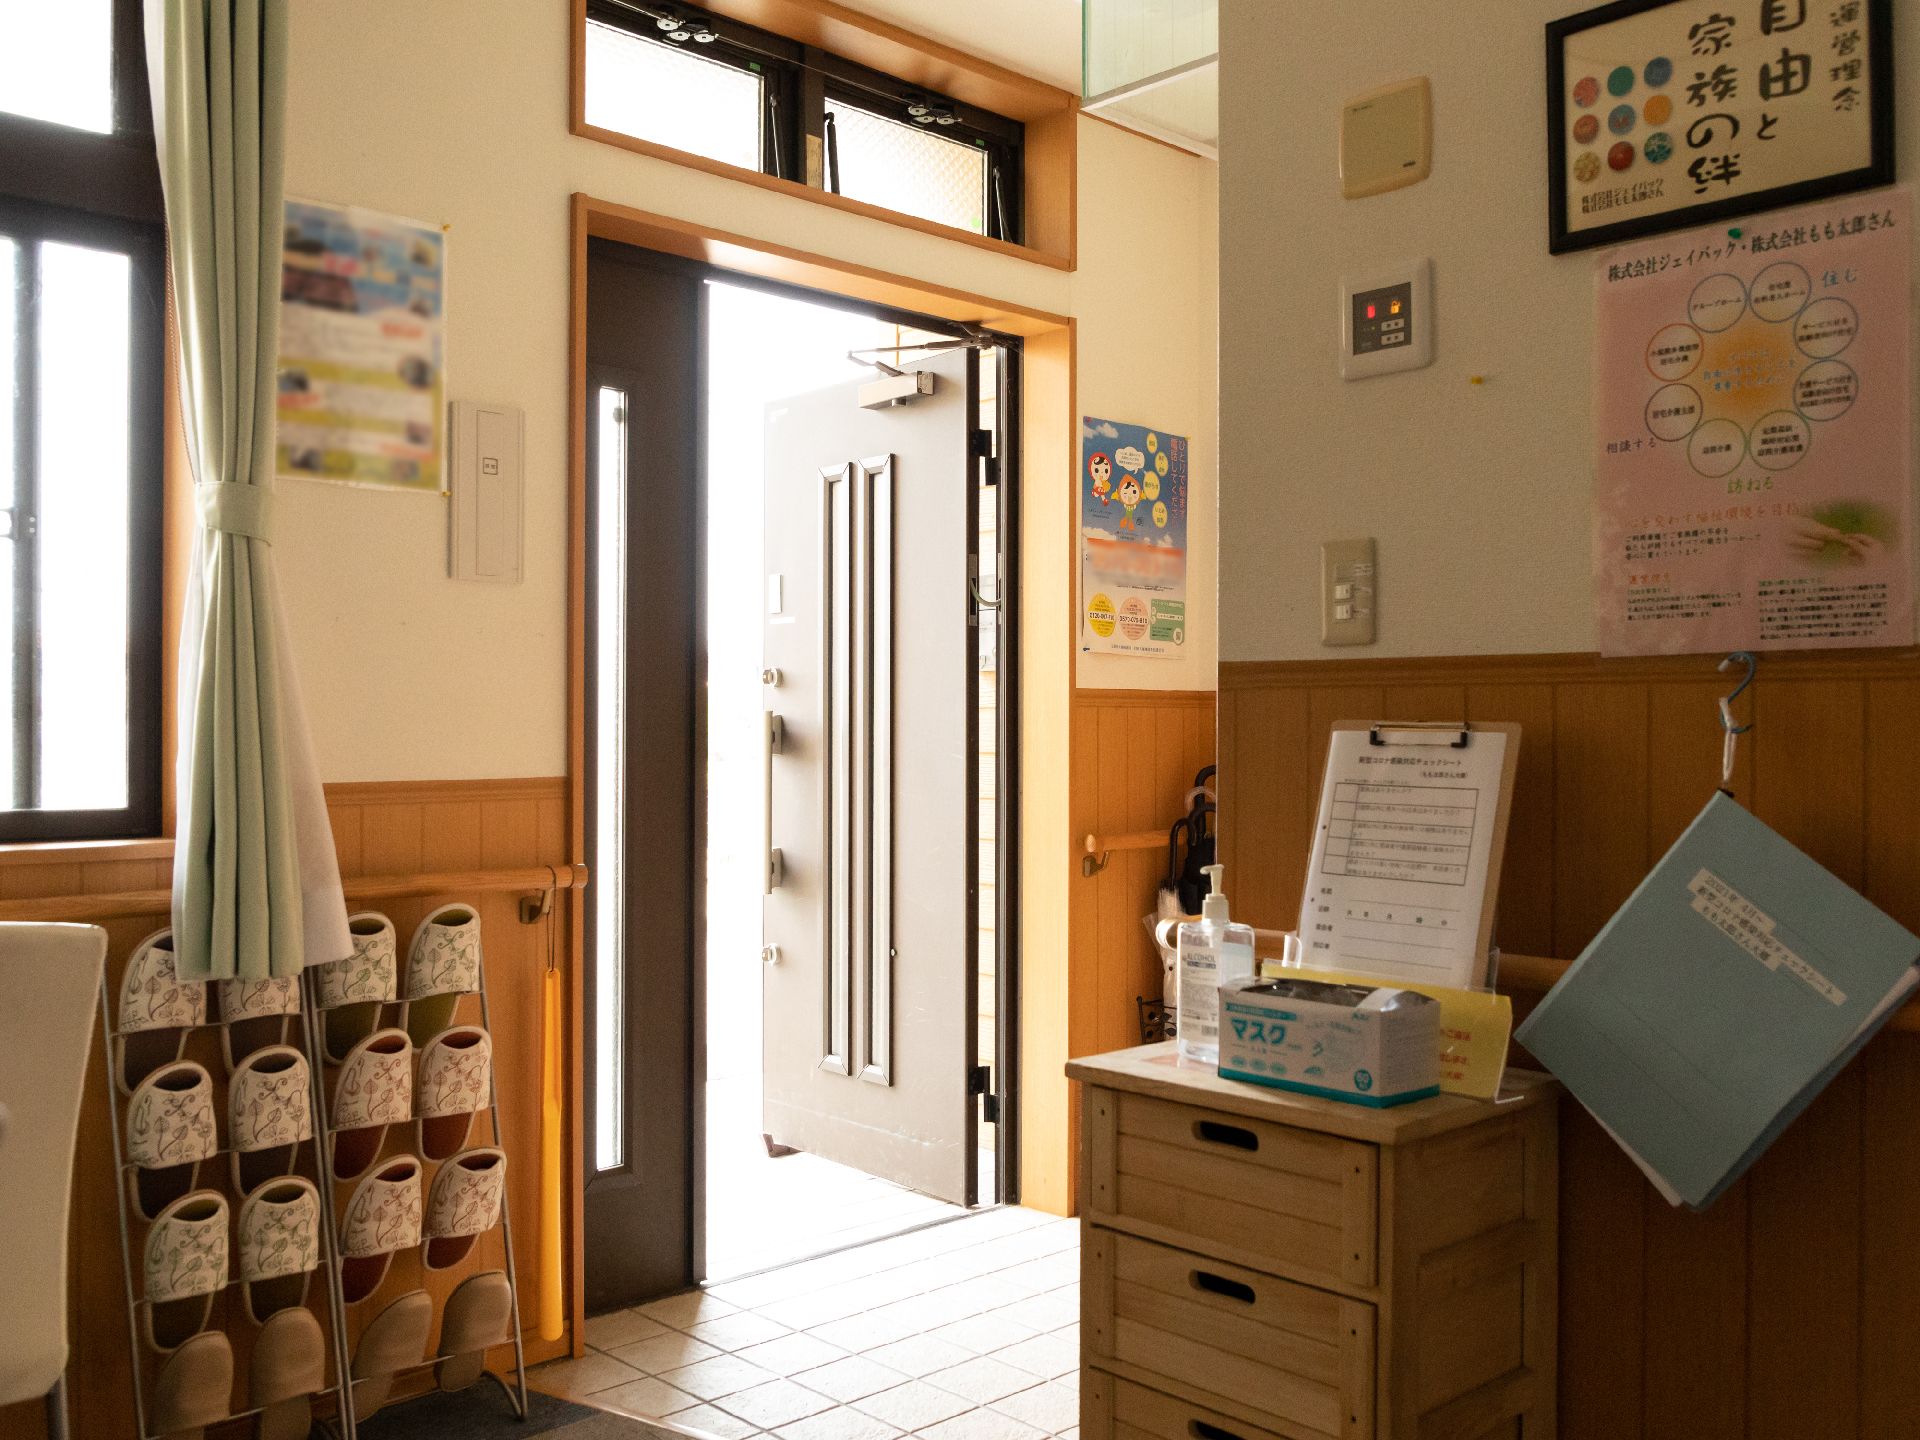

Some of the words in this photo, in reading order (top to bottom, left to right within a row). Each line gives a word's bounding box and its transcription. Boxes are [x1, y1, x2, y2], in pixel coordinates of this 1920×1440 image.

[1828, 1, 1863, 112] 運営理念
[1686, 13, 1741, 194] 家族の絆
[1606, 438, 1657, 454] 相談する
[1231, 1018, 1287, 1046] マスク
